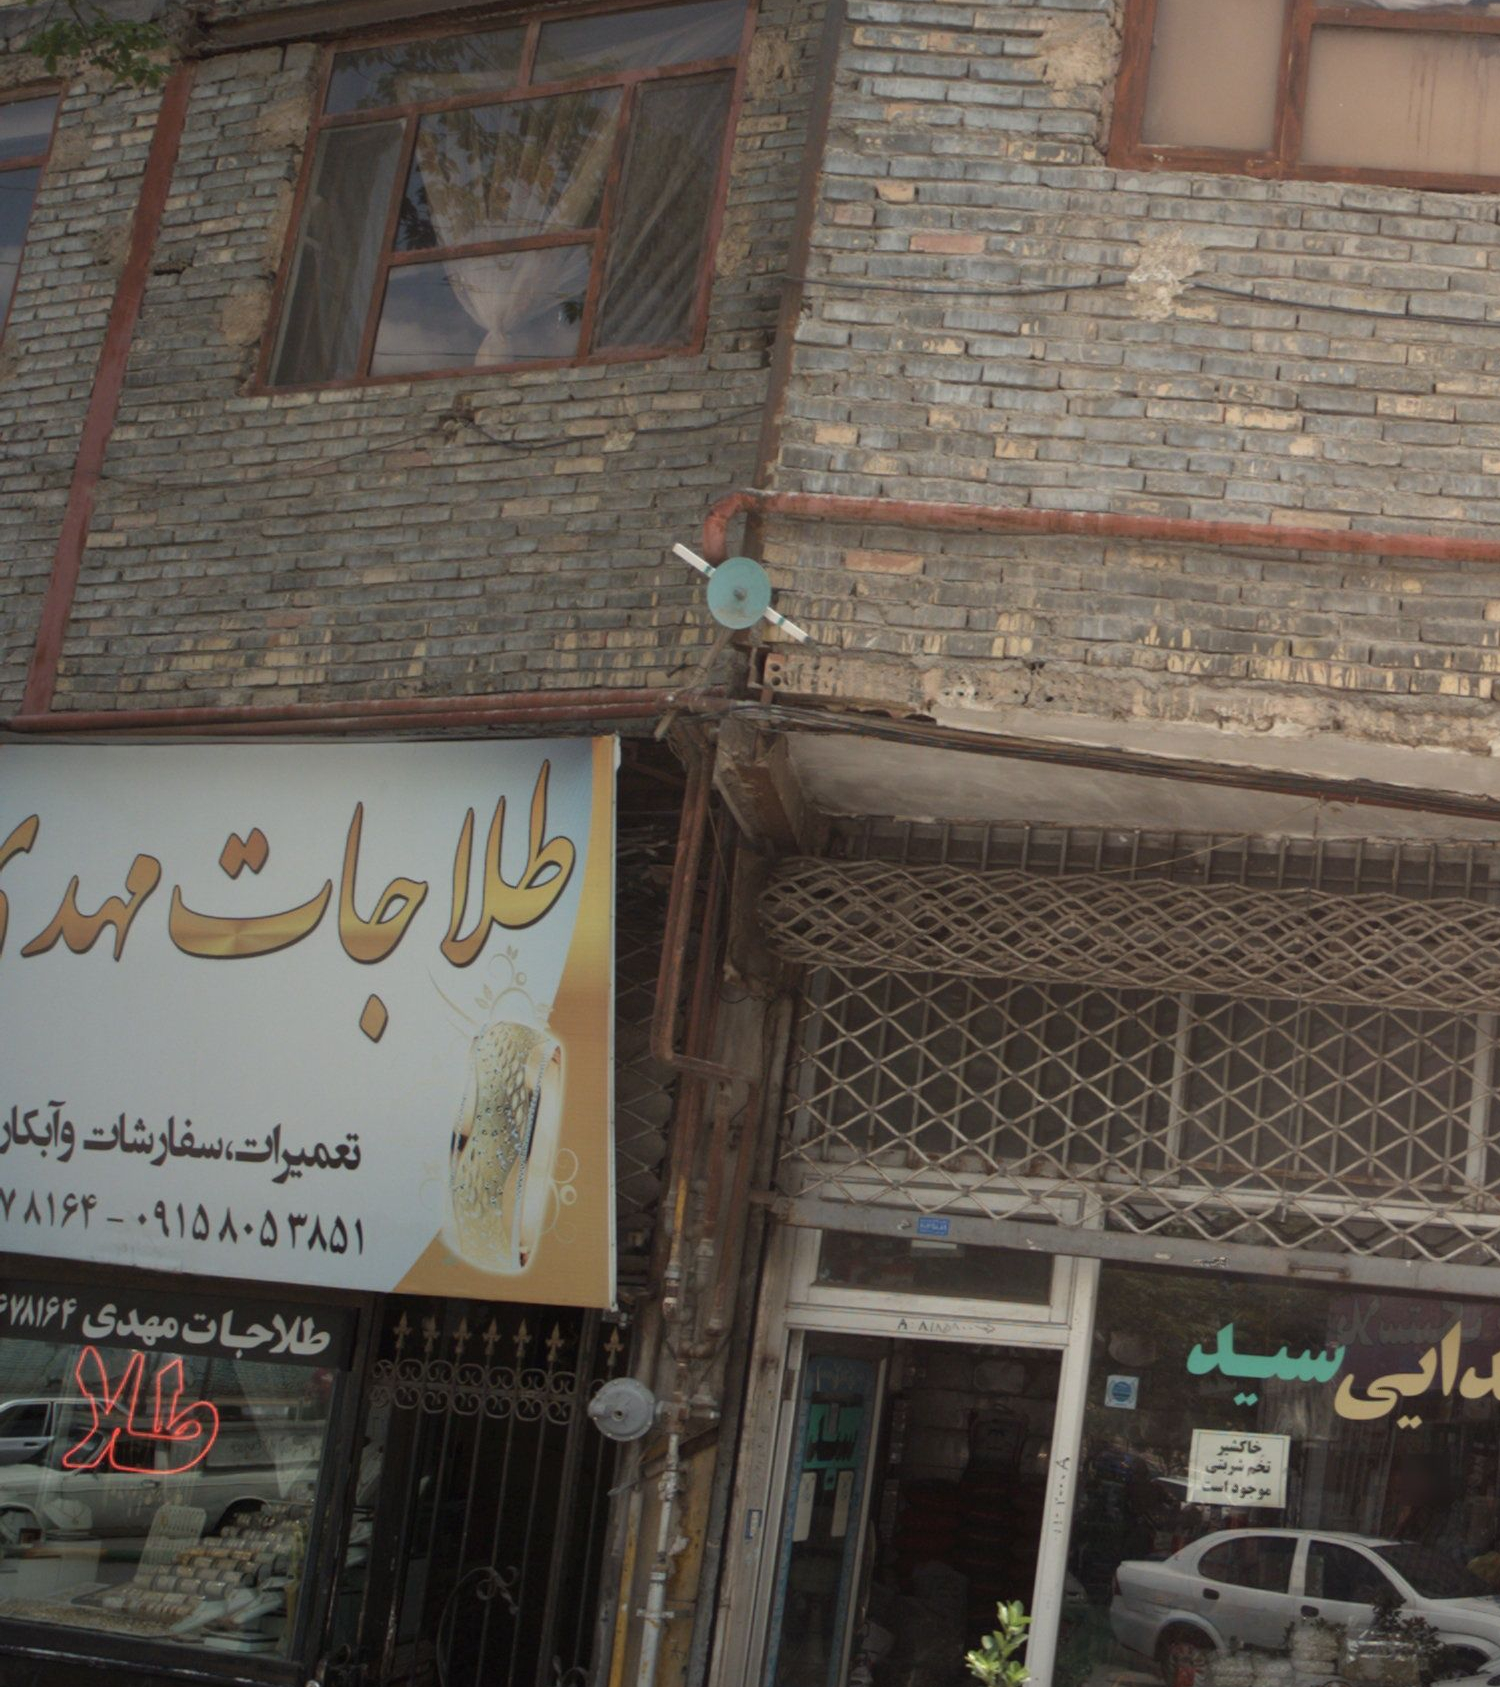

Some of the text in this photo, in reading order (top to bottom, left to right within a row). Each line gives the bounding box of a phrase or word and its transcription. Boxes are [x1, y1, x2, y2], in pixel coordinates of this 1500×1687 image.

[81, 1303, 180, 1346] مهدی
[1186, 1323, 1346, 1406] سید
[63, 1346, 219, 1475] طلا
[1217, 1440, 1262, 1456] خاکشیر
[1247, 1459, 1271, 1476] تخم
[1232, 1483, 1271, 1500] موجود
